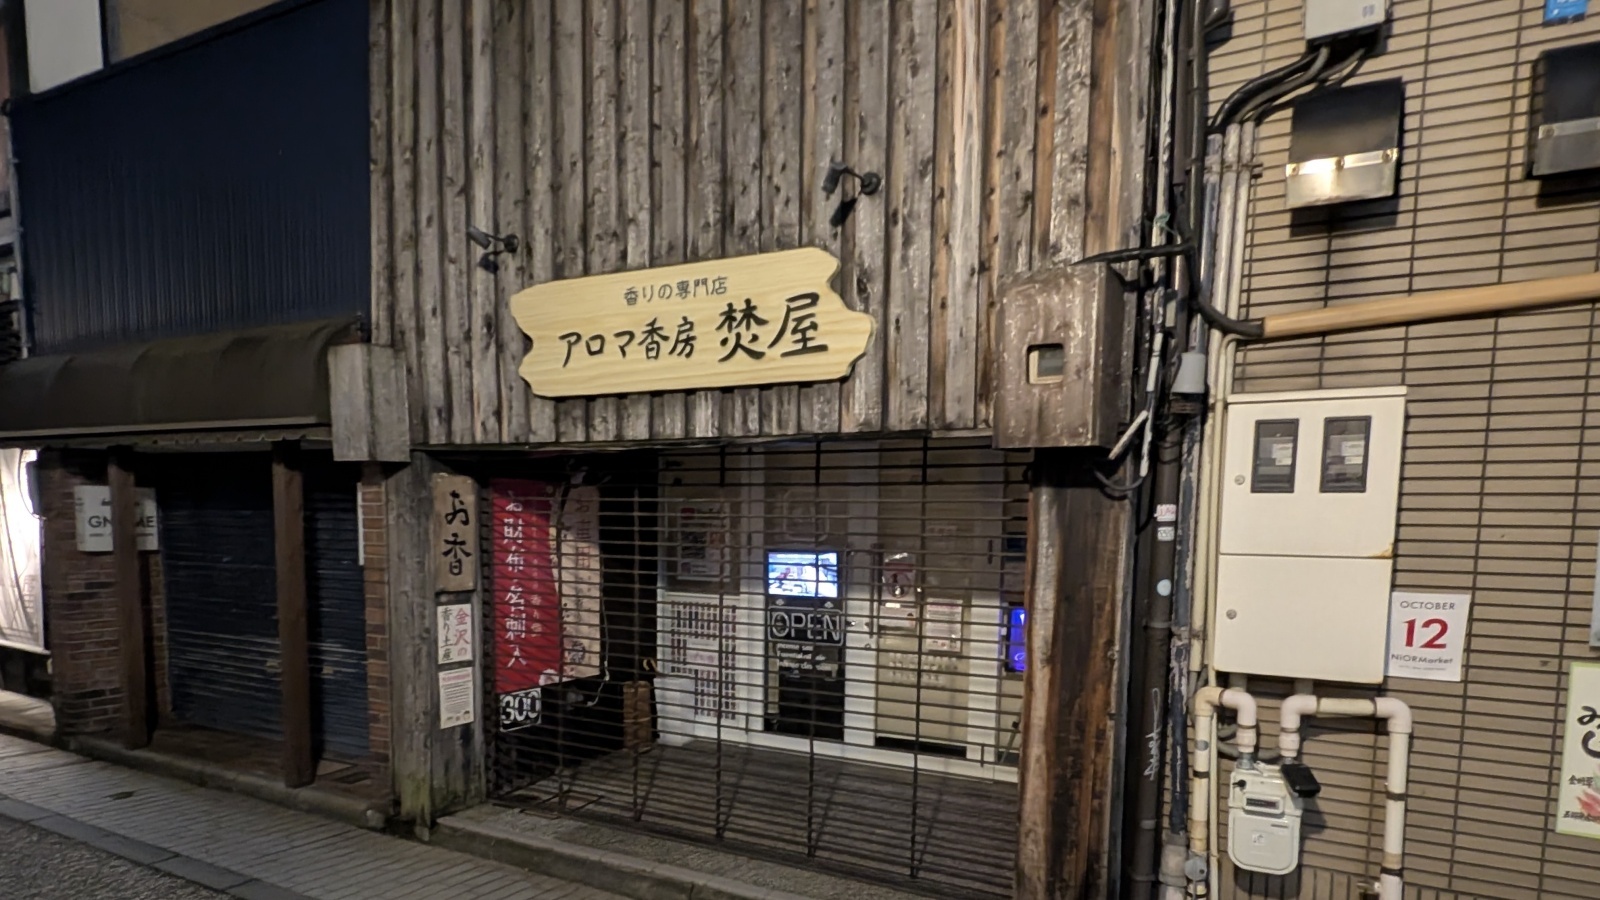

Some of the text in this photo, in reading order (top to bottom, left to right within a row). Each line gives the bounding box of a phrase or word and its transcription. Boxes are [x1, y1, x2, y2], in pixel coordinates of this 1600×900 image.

[623, 276, 728, 306] 香りの専門店
[558, 292, 829, 368] アロマ香房 焚屋
[442, 490, 472, 576] お香
[1399, 600, 1456, 611] OCTOBER
[455, 607, 470, 657] 金沢の
[771, 611, 840, 640] OPEN
[1402, 617, 1449, 649] 12
